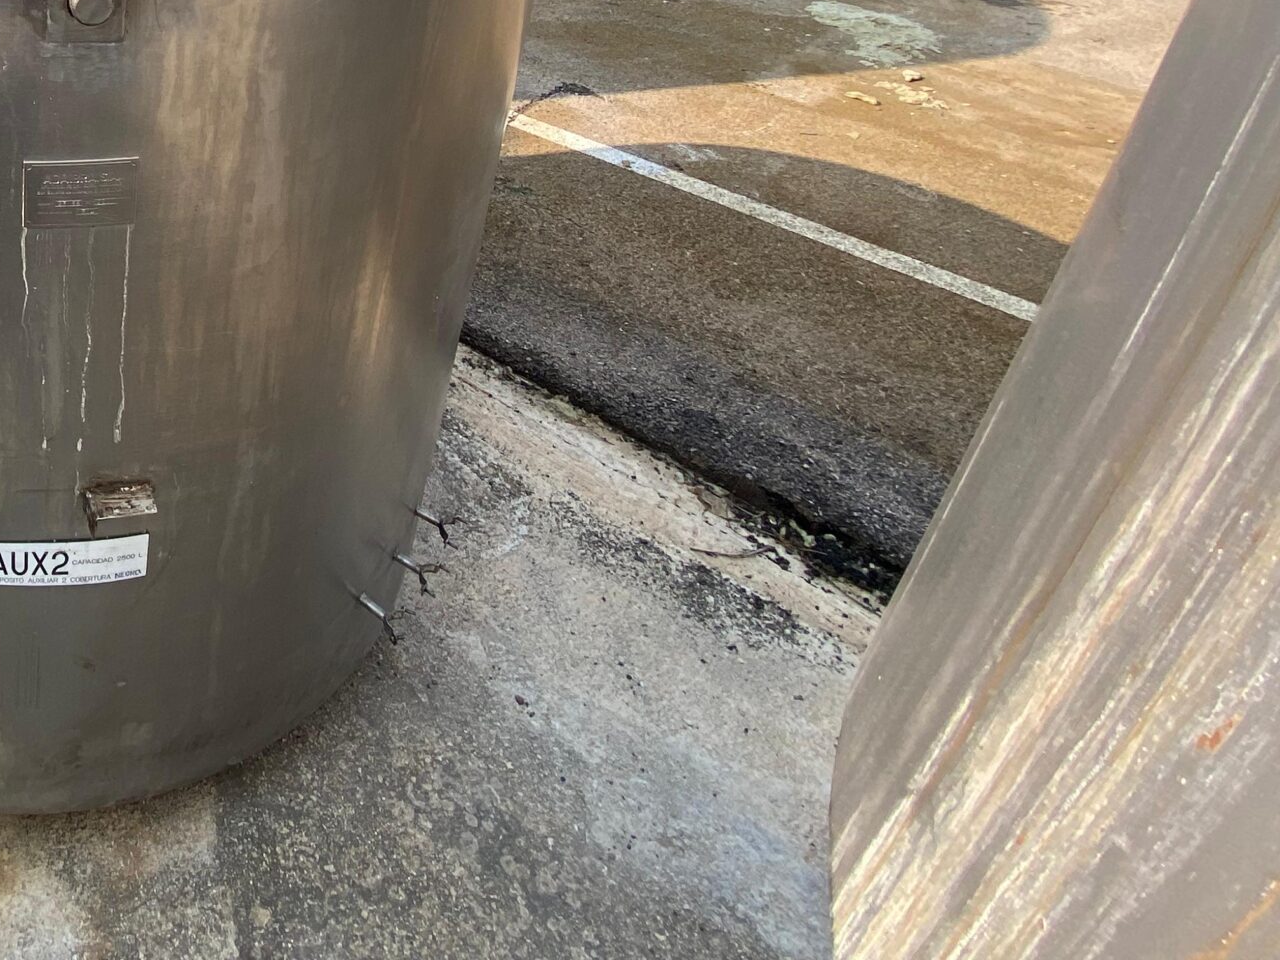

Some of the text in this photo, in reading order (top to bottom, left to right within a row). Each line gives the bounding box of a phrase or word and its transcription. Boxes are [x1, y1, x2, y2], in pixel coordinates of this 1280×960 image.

[71, 556, 114, 566] CAPACIDAD
[116, 553, 136, 562] 2500
[69, 573, 112, 583] COBERTURA
